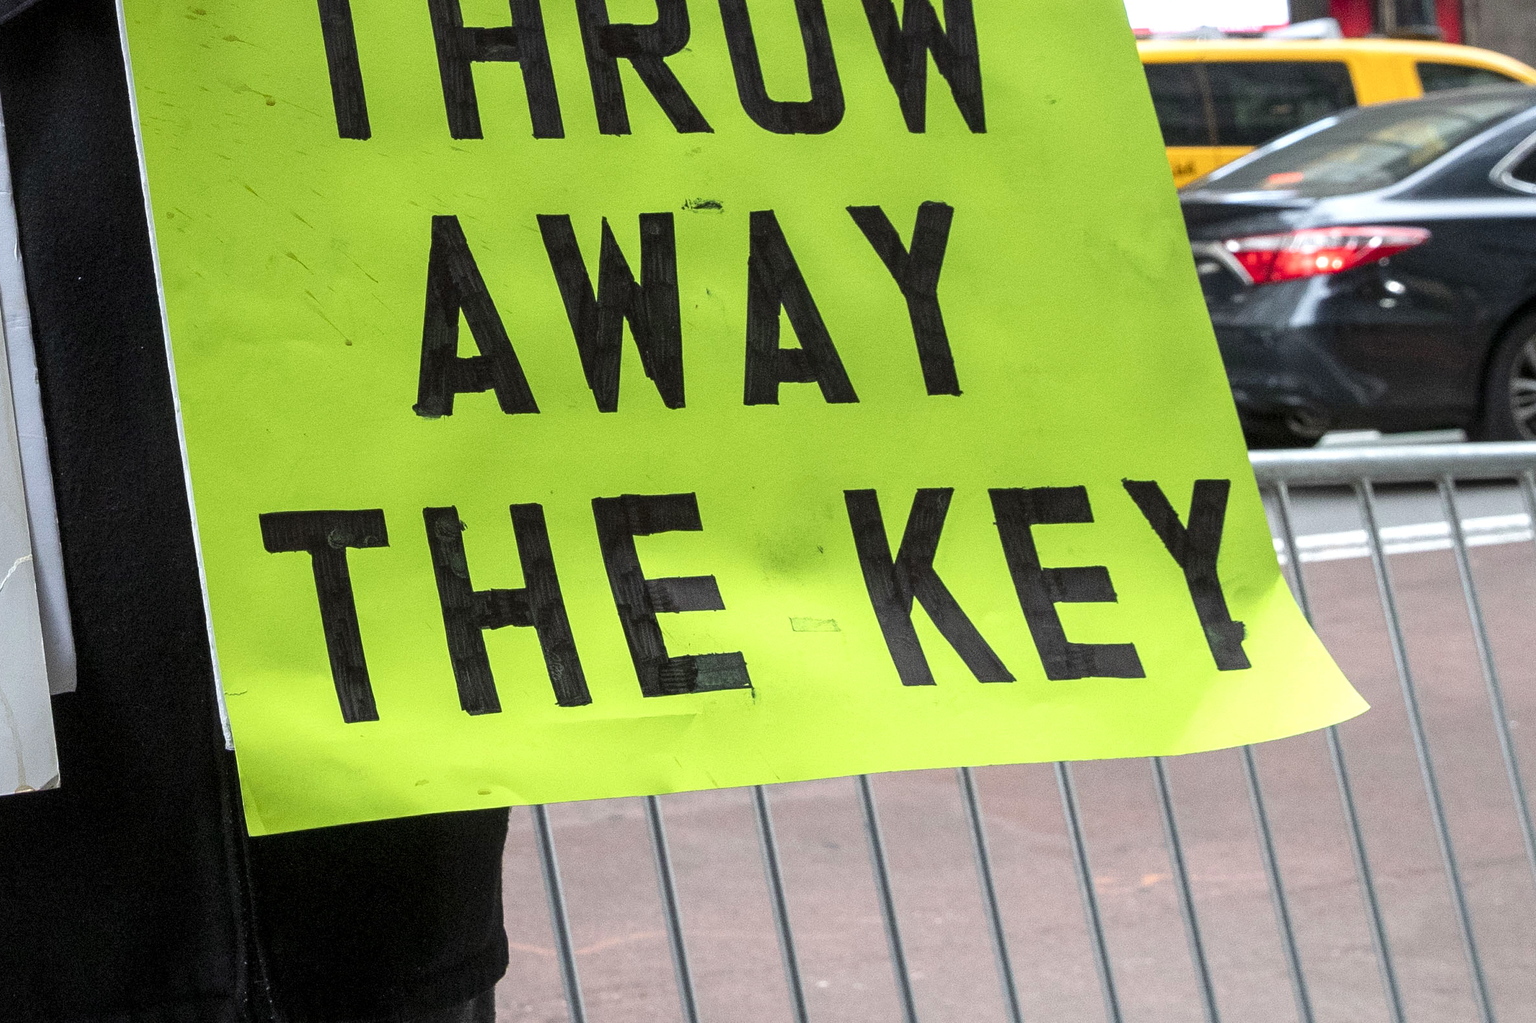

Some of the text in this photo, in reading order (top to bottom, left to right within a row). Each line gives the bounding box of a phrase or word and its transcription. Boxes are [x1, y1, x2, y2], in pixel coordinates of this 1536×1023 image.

[412, 201, 963, 418] AWAY
[260, 478, 1250, 723] THE KEY
